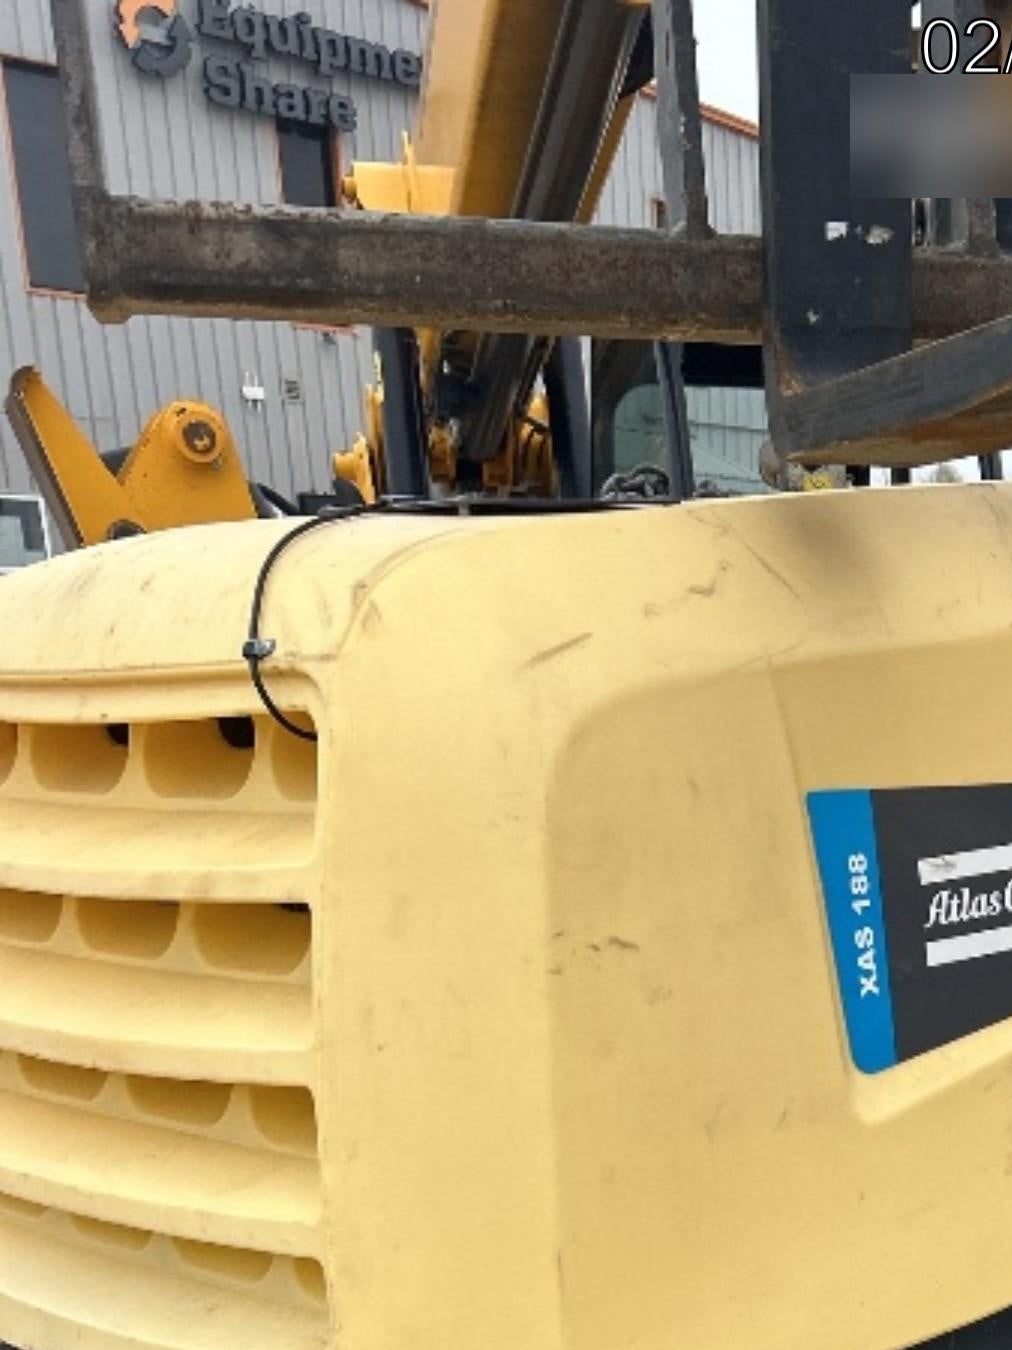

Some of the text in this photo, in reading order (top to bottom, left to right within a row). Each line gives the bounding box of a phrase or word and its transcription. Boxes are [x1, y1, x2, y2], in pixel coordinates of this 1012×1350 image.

[198, 0, 423, 86] Equipme
[203, 55, 358, 131] Share
[848, 852, 880, 998] XAS 188
